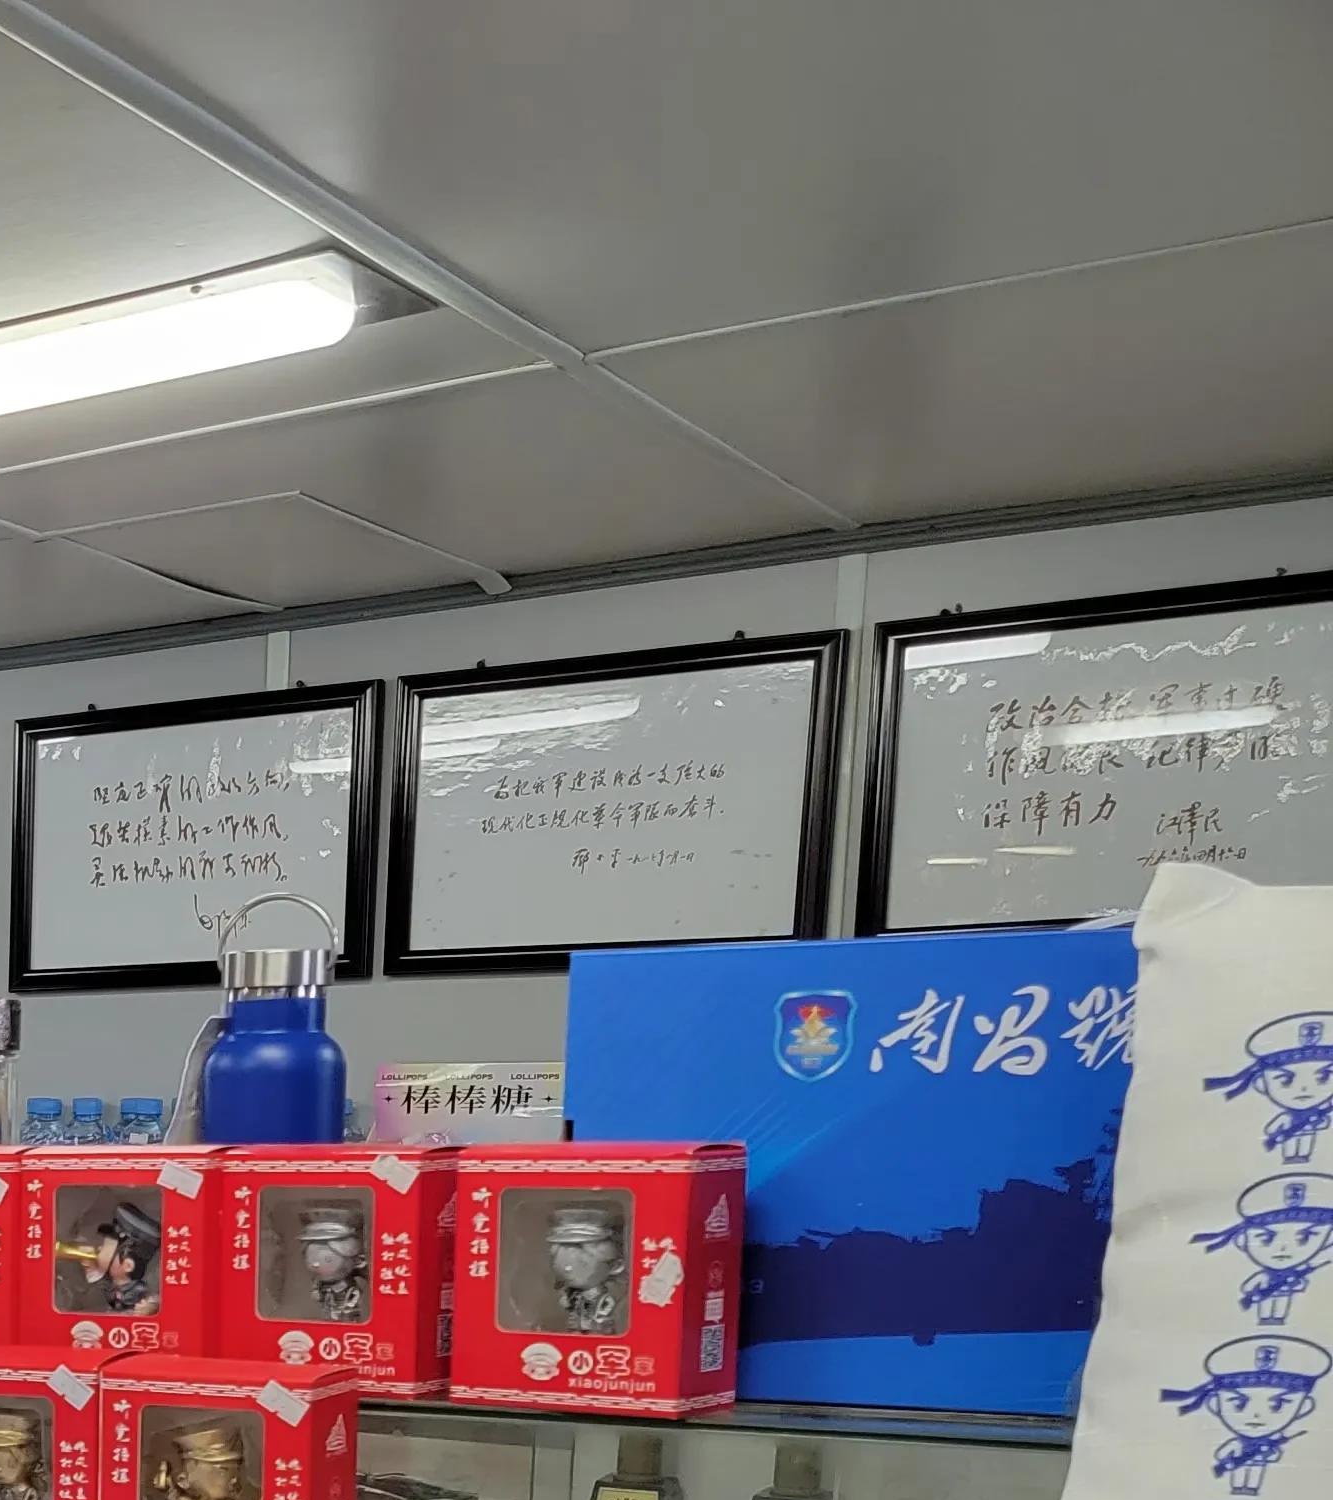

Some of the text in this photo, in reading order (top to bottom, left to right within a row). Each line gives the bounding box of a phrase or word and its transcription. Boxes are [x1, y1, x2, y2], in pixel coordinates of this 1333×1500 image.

[983, 790, 1117, 836] 保障有力
[510, 1072, 560, 1080] LOLLIPOPS
[400, 1084, 534, 1116] 棒棒糖
[568, 1376, 656, 1393] xiaojunjun
